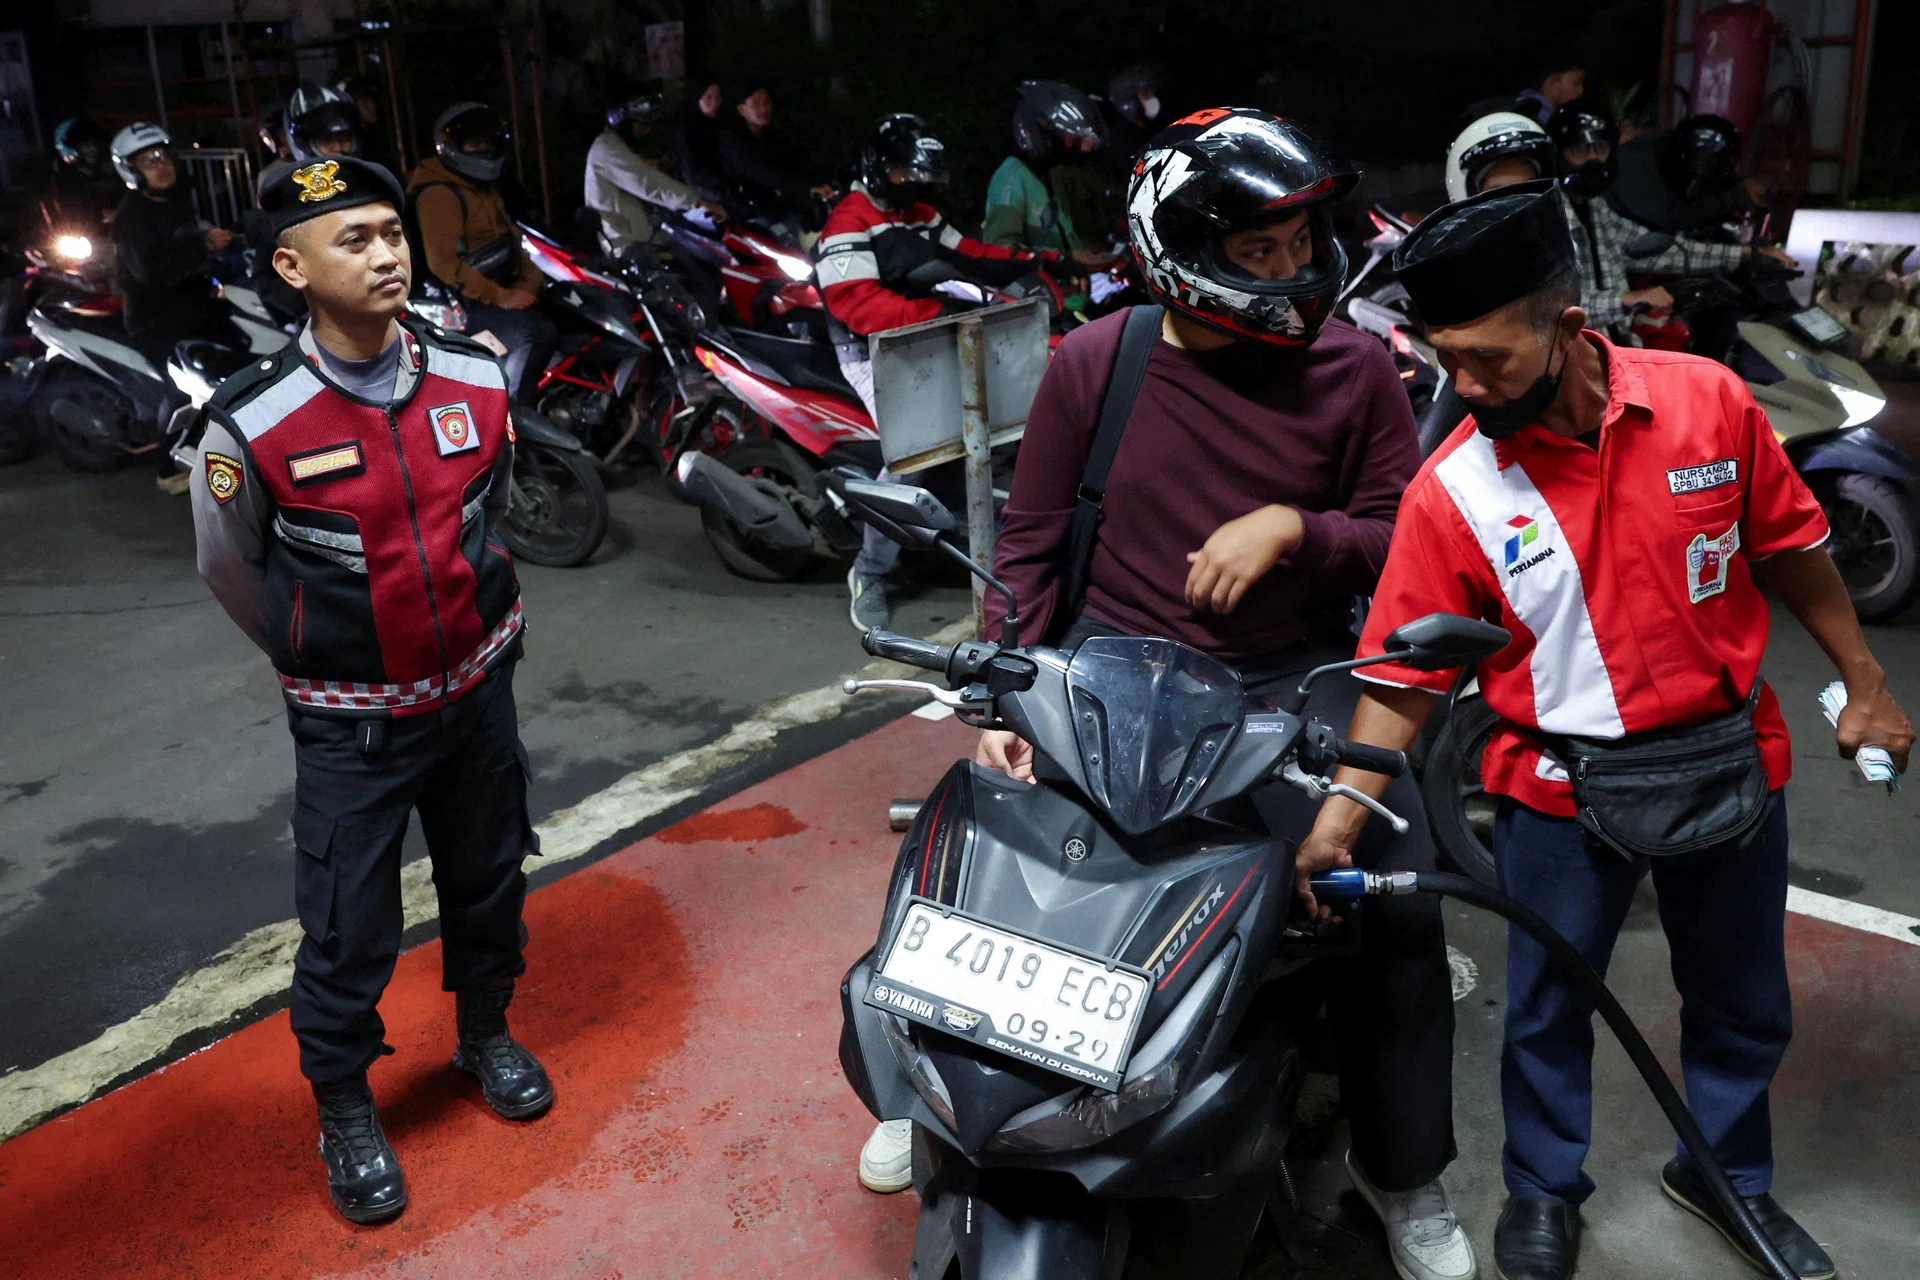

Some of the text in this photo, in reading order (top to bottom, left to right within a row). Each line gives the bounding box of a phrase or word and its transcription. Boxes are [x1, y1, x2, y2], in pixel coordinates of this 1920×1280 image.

[1673, 478, 1699, 491] SPBU
[1674, 461, 1729, 482] NURSAMSU
[1508, 547, 1556, 578] PERTAMINA
[903, 915, 1132, 1021] B 4019 ECB
[887, 989, 934, 1020] YAMAHA
[986, 1037, 1109, 1084] SEMAKIN DI DEPAN
